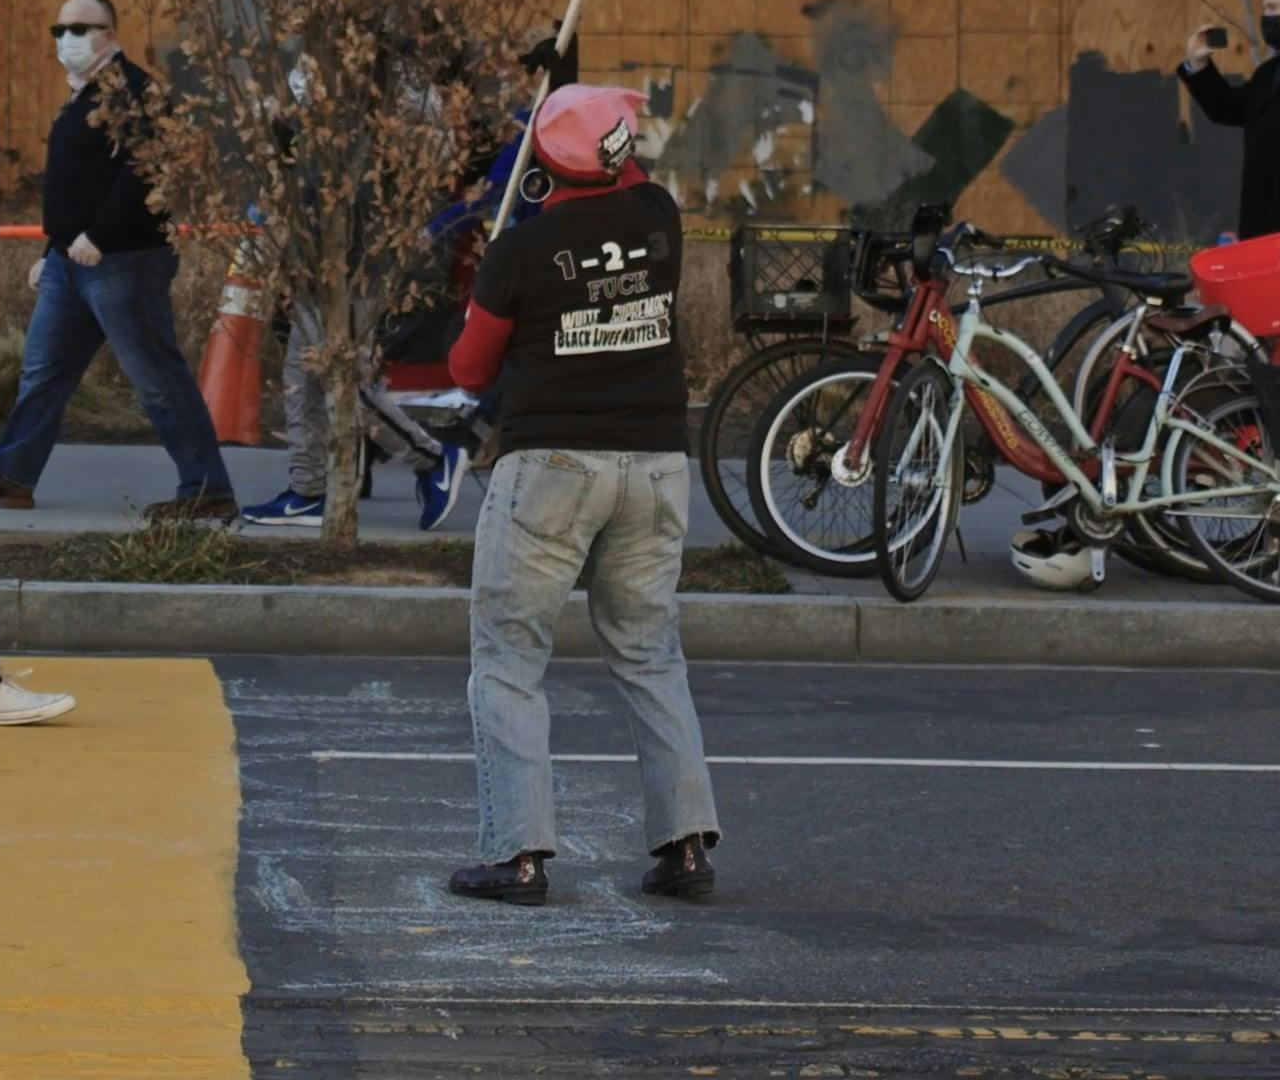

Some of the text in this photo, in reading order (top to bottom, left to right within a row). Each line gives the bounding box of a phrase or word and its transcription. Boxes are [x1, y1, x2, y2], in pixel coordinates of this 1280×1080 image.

[587, 270, 650, 303] FUCK
[558, 328, 592, 349] BLACK
[621, 323, 658, 345] MATTER
